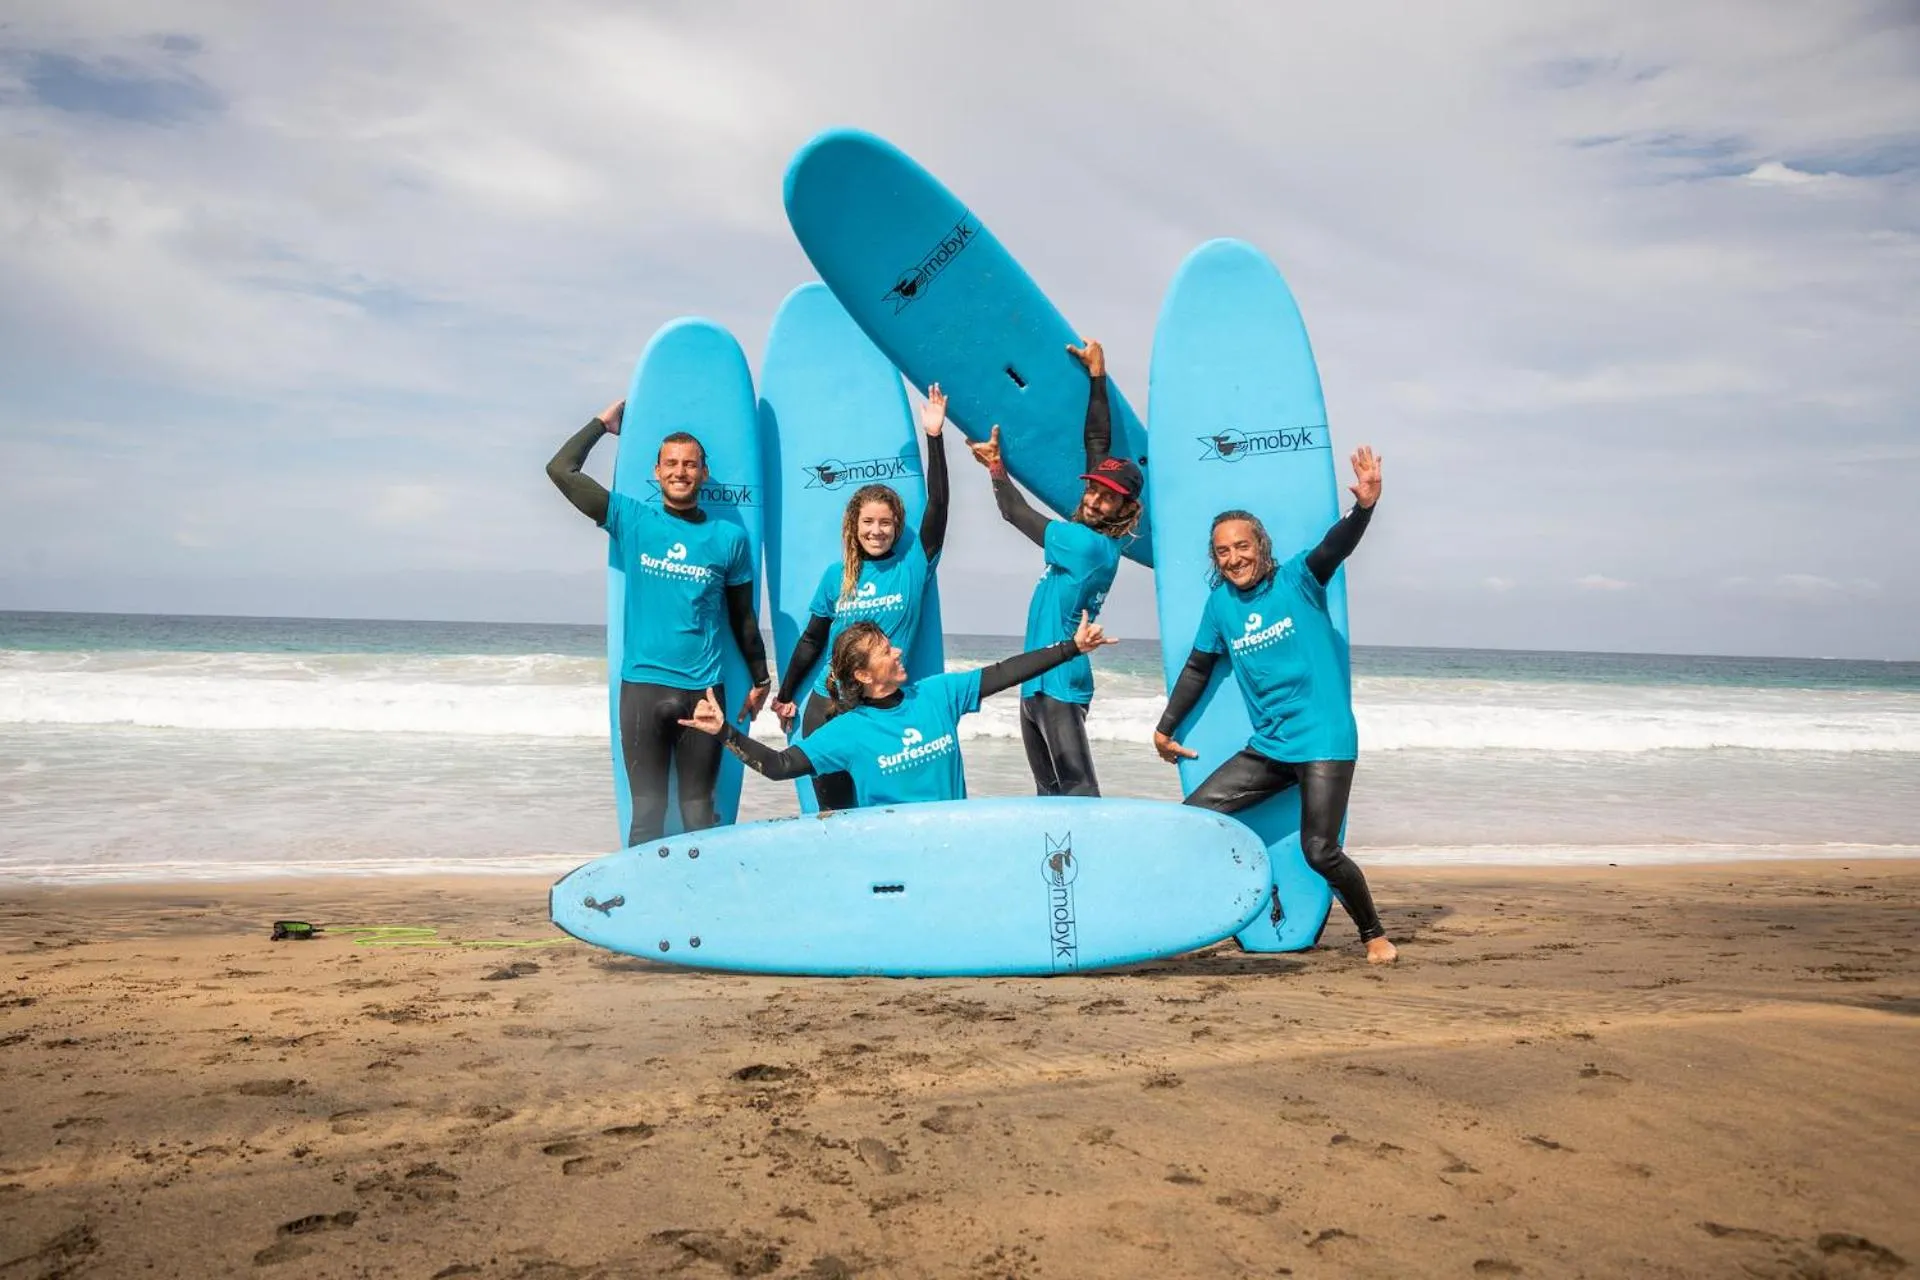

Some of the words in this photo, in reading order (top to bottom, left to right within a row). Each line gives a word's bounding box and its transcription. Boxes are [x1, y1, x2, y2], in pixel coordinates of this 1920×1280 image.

[922, 223, 973, 278] mobyk
[1249, 427, 1313, 452] mobyk
[848, 457, 906, 479] mobyk
[640, 553, 713, 580] Surfescape
[877, 733, 953, 769] Surfescape
[1051, 887, 1077, 958] mobyk
